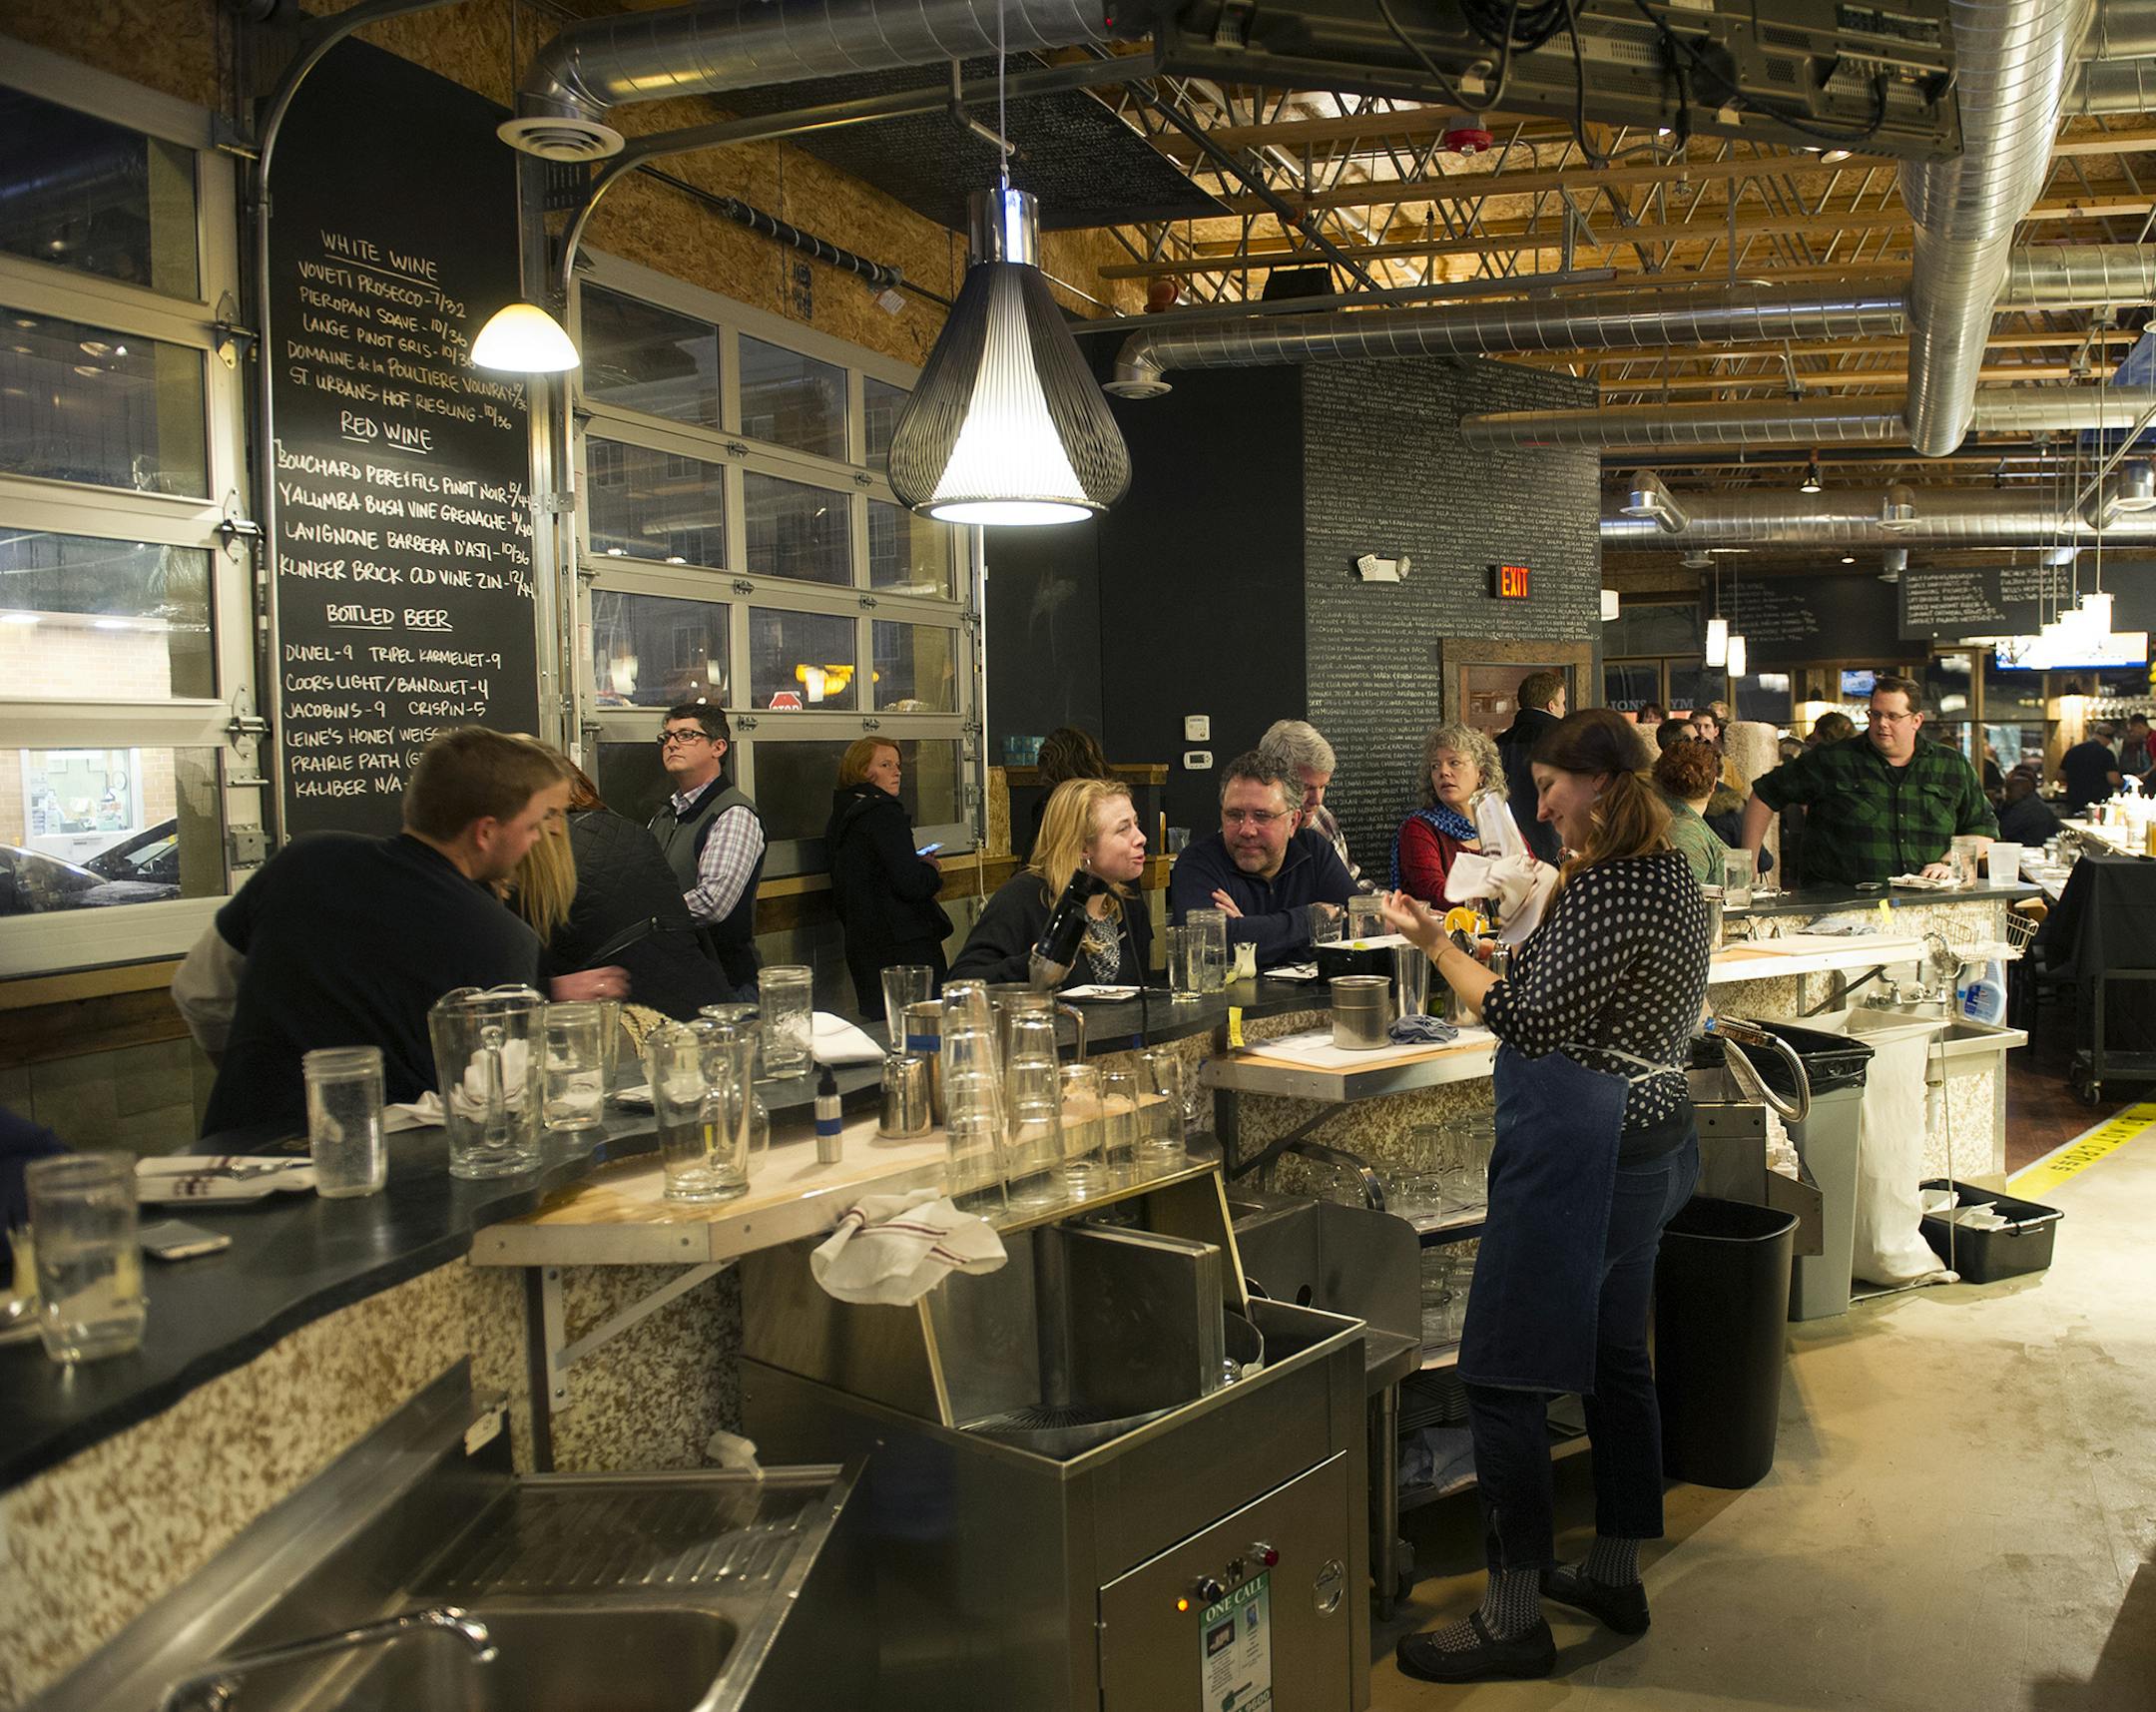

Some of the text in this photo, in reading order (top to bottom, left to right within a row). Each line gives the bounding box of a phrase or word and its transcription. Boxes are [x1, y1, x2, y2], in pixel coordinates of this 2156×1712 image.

[320, 230, 438, 282] WHITE WINE
[299, 286, 370, 318] PIEROPAN
[303, 313, 349, 337] LANGE
[357, 330, 393, 348] PINOT
[287, 340, 355, 370] DOMAINE
[341, 410, 433, 449] RED WINE
[277, 446, 361, 479] BOUCHARD
[443, 478, 477, 497] PINOT
[278, 481, 360, 510] YALUMBA
[364, 495, 403, 517] BUSH
[408, 502, 436, 519] VINE
[284, 521, 379, 550] LAVIGNONE
[387, 530, 449, 556] BARBERA
[279, 553, 347, 579] KLINKER
[352, 561, 403, 584] BRICK
[410, 567, 436, 585] OLD
[439, 571, 472, 588] VINE
[1501, 566, 1530, 598] EXIT
[327, 604, 454, 629] BOTTLED BEER
[369, 647, 415, 663] TRIPEL
[285, 674, 332, 692] COORS
[286, 728, 343, 748] LEINE'S
[349, 727, 395, 745] HONEY
[291, 755, 353, 774] PRAIRIE
[359, 754, 400, 770] PATH
[295, 779, 367, 798] KALIBER
[2094, 1129, 2133, 1144] NOT
[2050, 1145, 2106, 1171] CROSS
[1206, 1578, 1264, 1622] ONE CALL
